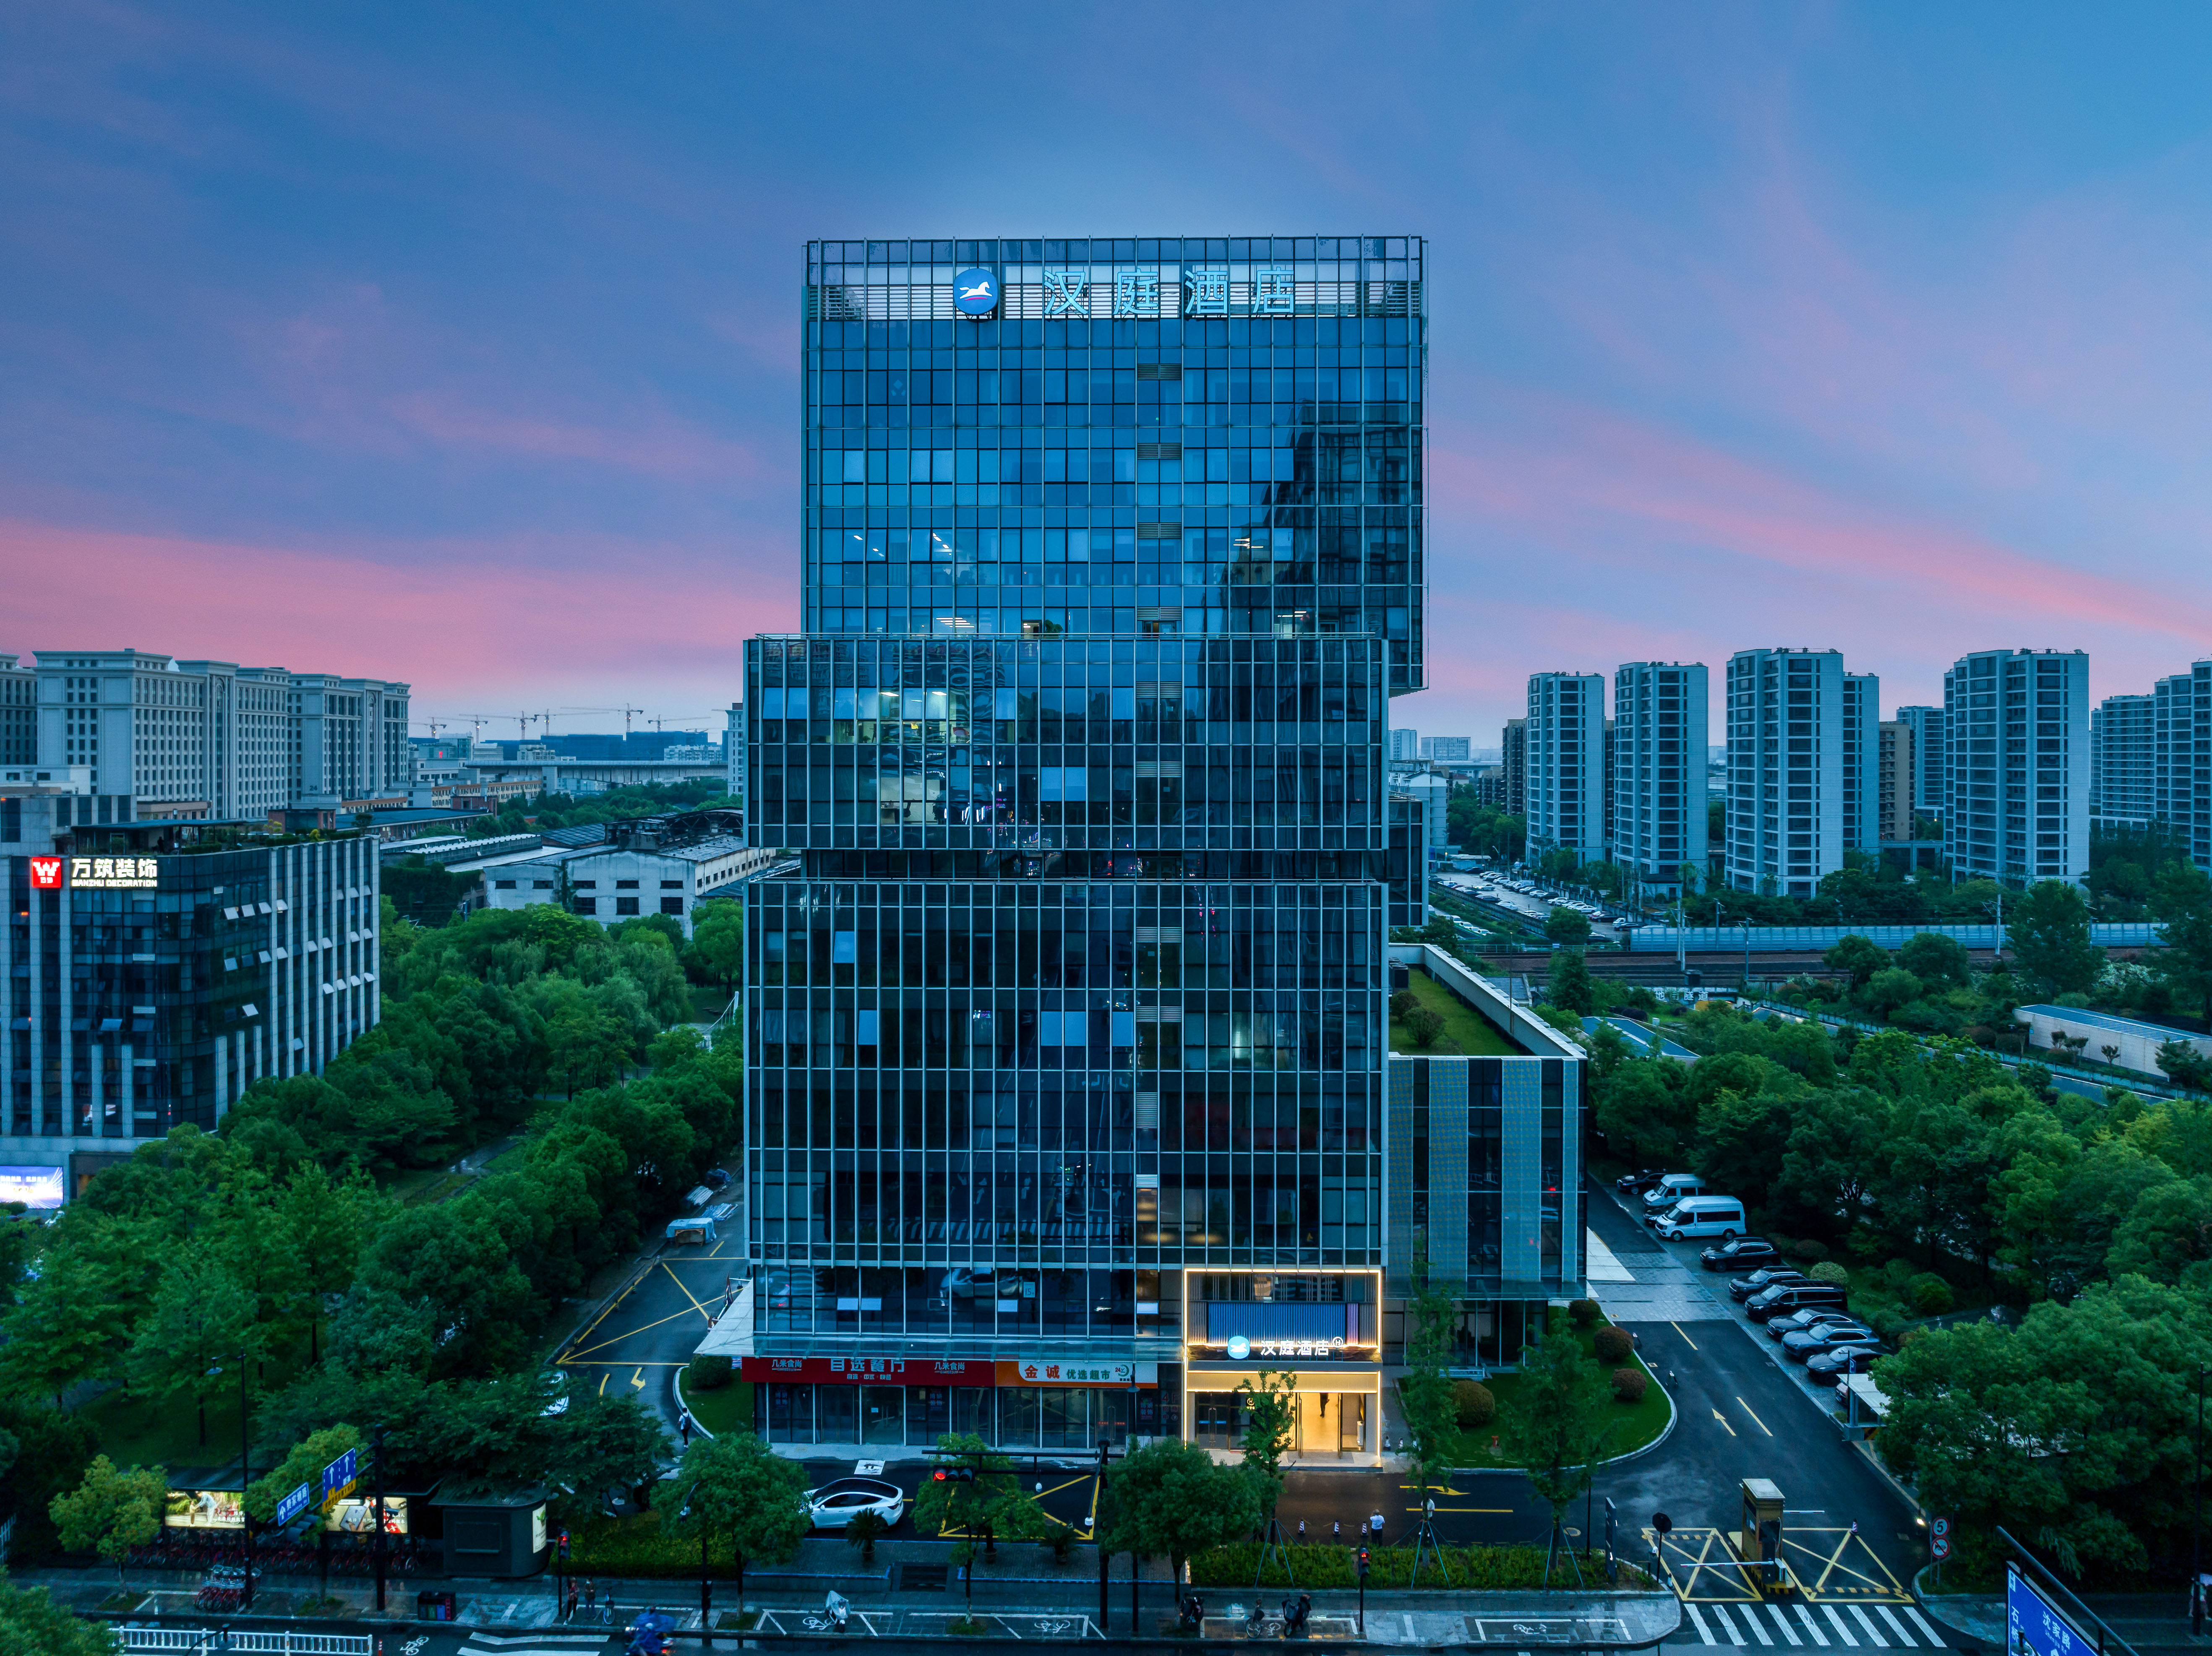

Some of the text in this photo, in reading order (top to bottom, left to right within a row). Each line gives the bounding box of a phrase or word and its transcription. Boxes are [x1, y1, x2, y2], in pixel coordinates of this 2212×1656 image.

[1044, 268, 1294, 315] 汉庭酒店
[72, 858, 157, 878] 万筑装饰
[1260, 1339, 1329, 1357] 汉庭酒店
[772, 1359, 802, 1368] 几米食尚
[830, 1358, 905, 1372] 自选餐厅
[934, 1362, 965, 1370] 几米食尚
[1025, 1364, 1111, 1381] 金诚 优选超市
[1161, 1392, 1180, 1403] 4F
[1936, 1521, 1943, 1533] 5
[2042, 1610, 2071, 1650] 沈家路
